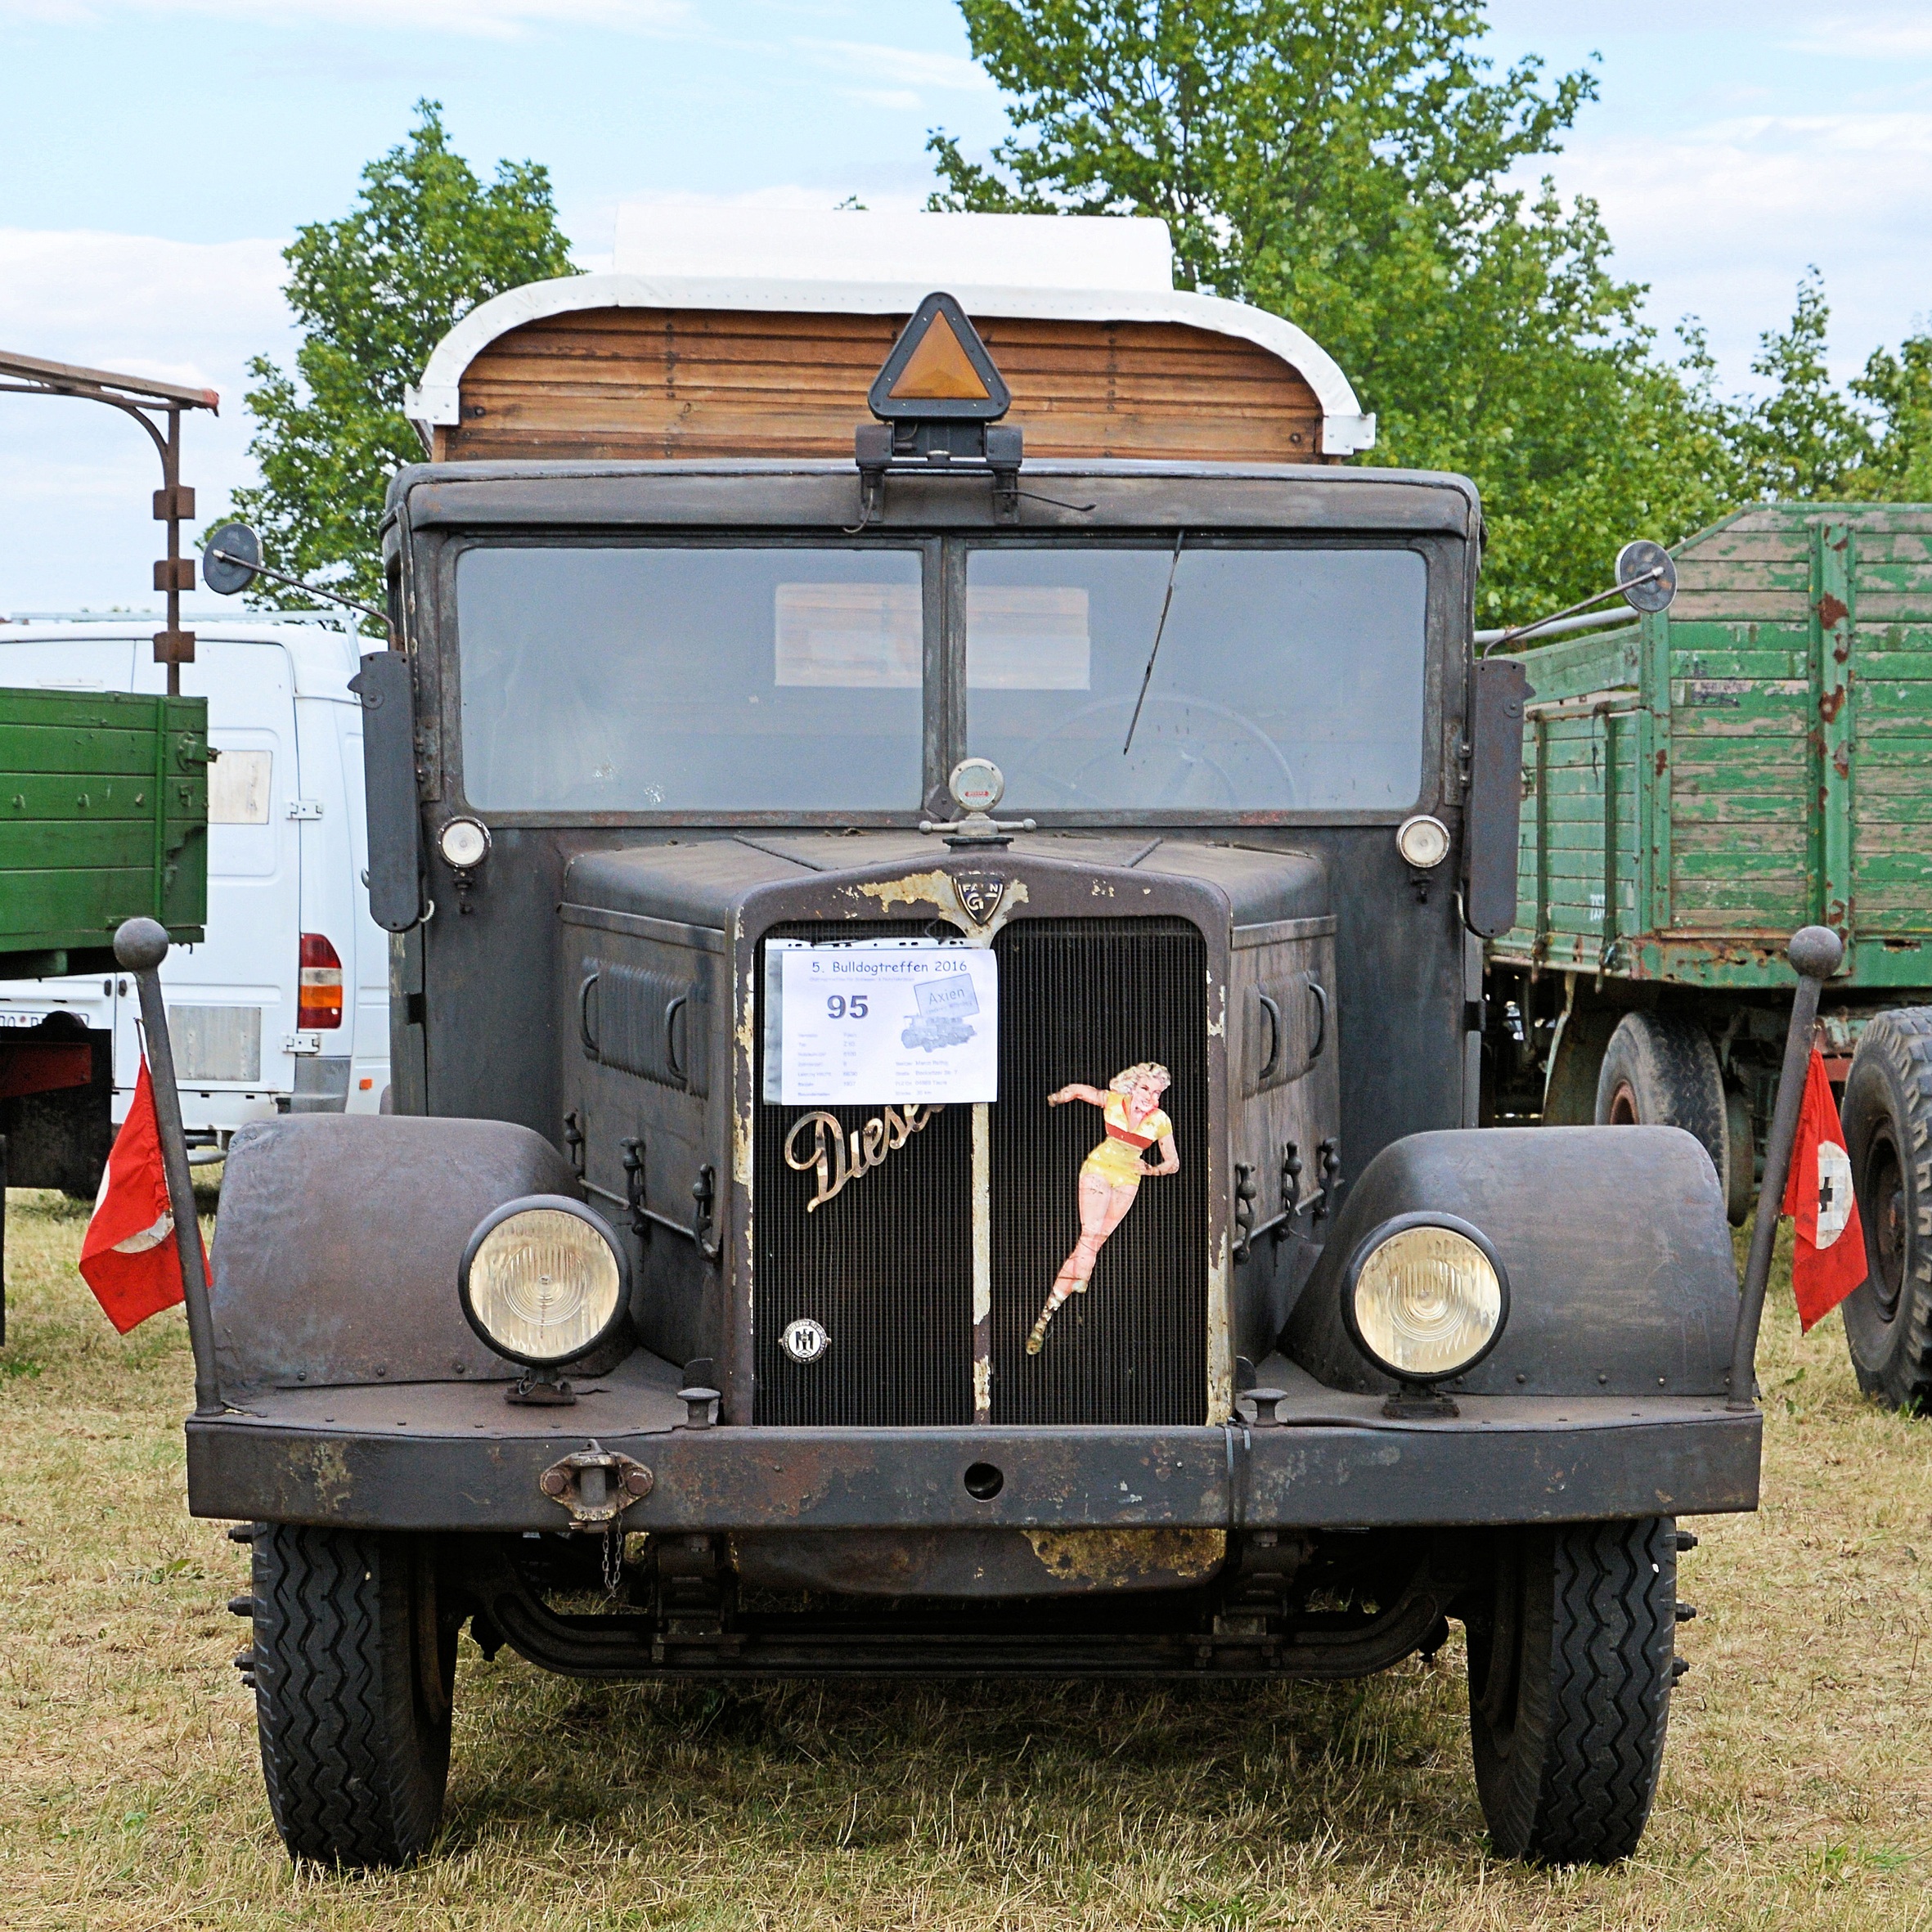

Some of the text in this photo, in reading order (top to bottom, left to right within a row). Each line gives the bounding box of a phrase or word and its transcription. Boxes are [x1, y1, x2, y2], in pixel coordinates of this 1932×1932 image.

[812, 960, 968, 976] 5. Bulldogtreffen 2016
[928, 987, 965, 1006] Axien
[827, 995, 869, 1019] 95
